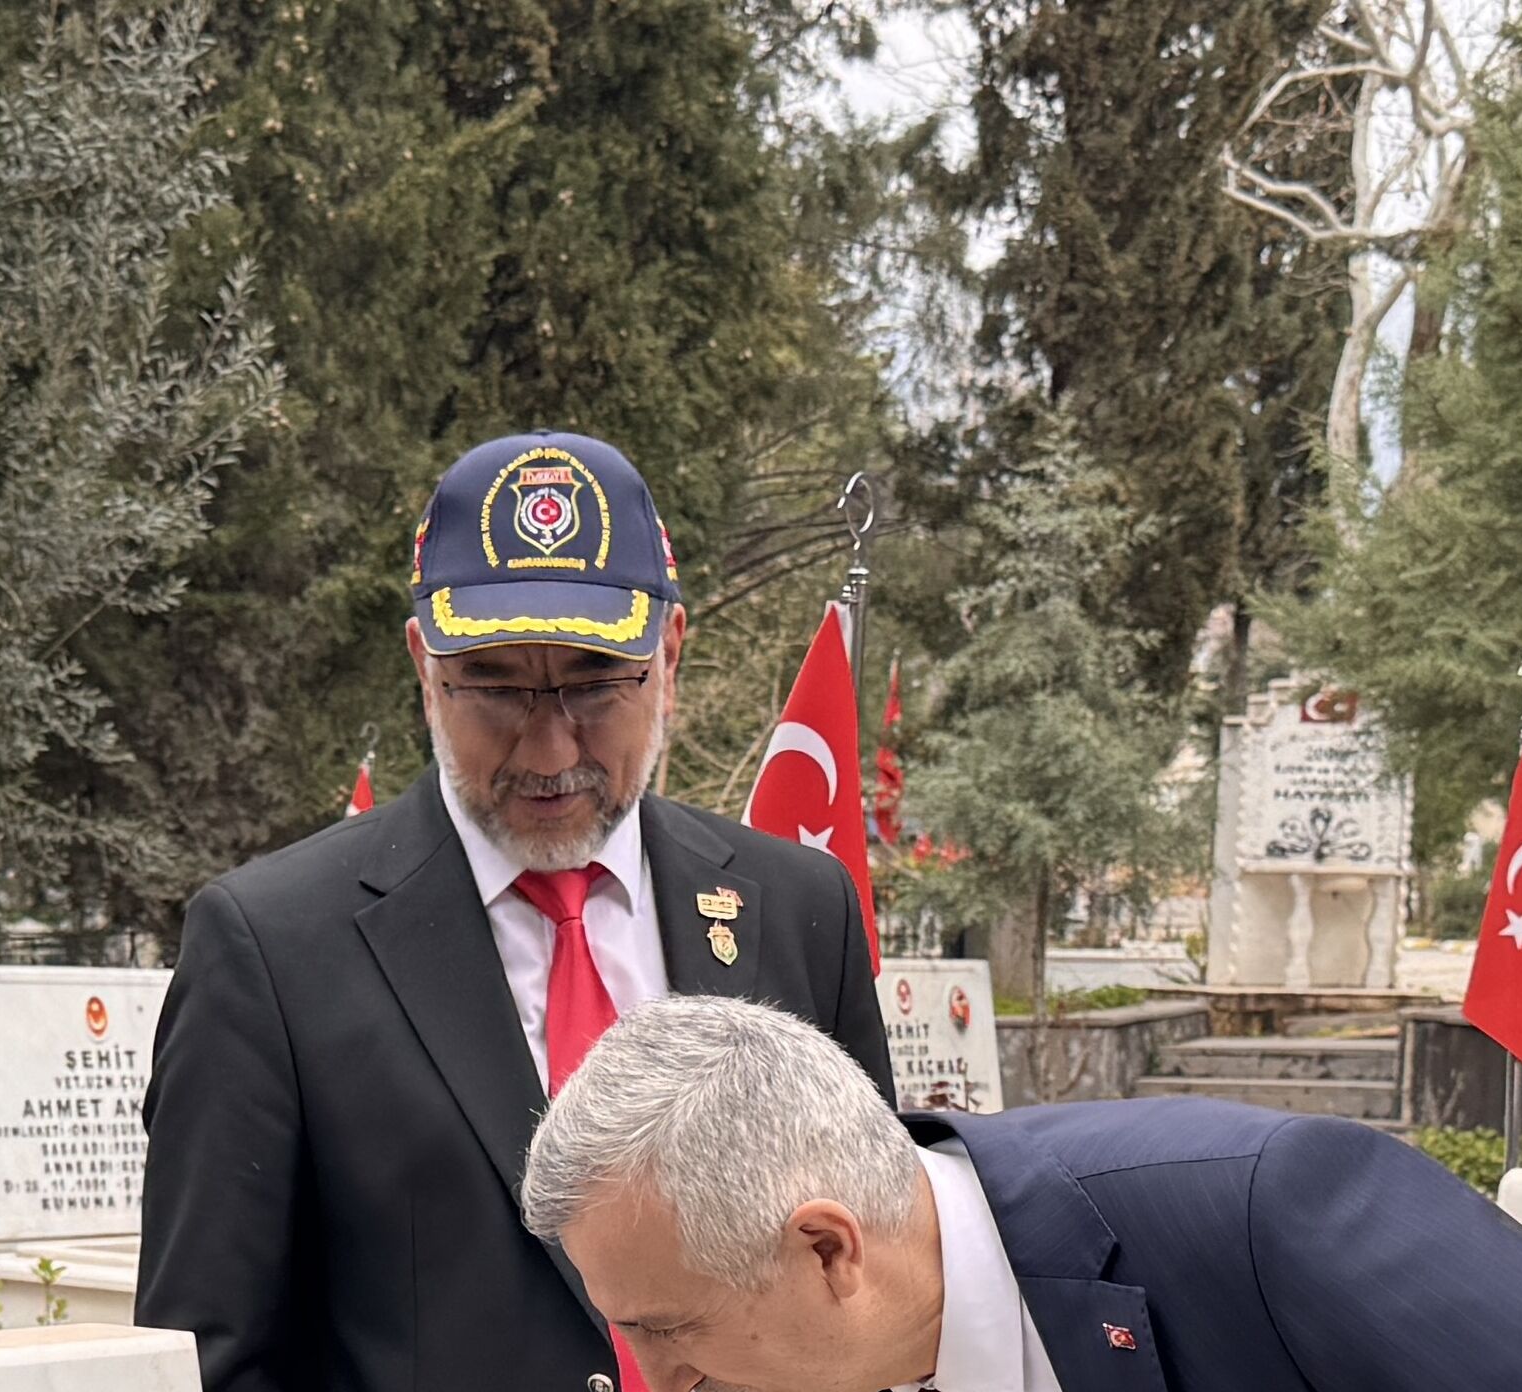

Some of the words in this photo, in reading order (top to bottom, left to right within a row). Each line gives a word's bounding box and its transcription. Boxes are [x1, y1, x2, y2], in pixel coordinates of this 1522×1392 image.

[65, 1045, 136, 1070] ŞEHİT
[23, 1099, 102, 1118] AHMET
[115, 1099, 144, 1118] AK
[42, 1195, 115, 1211] RUHUNA
